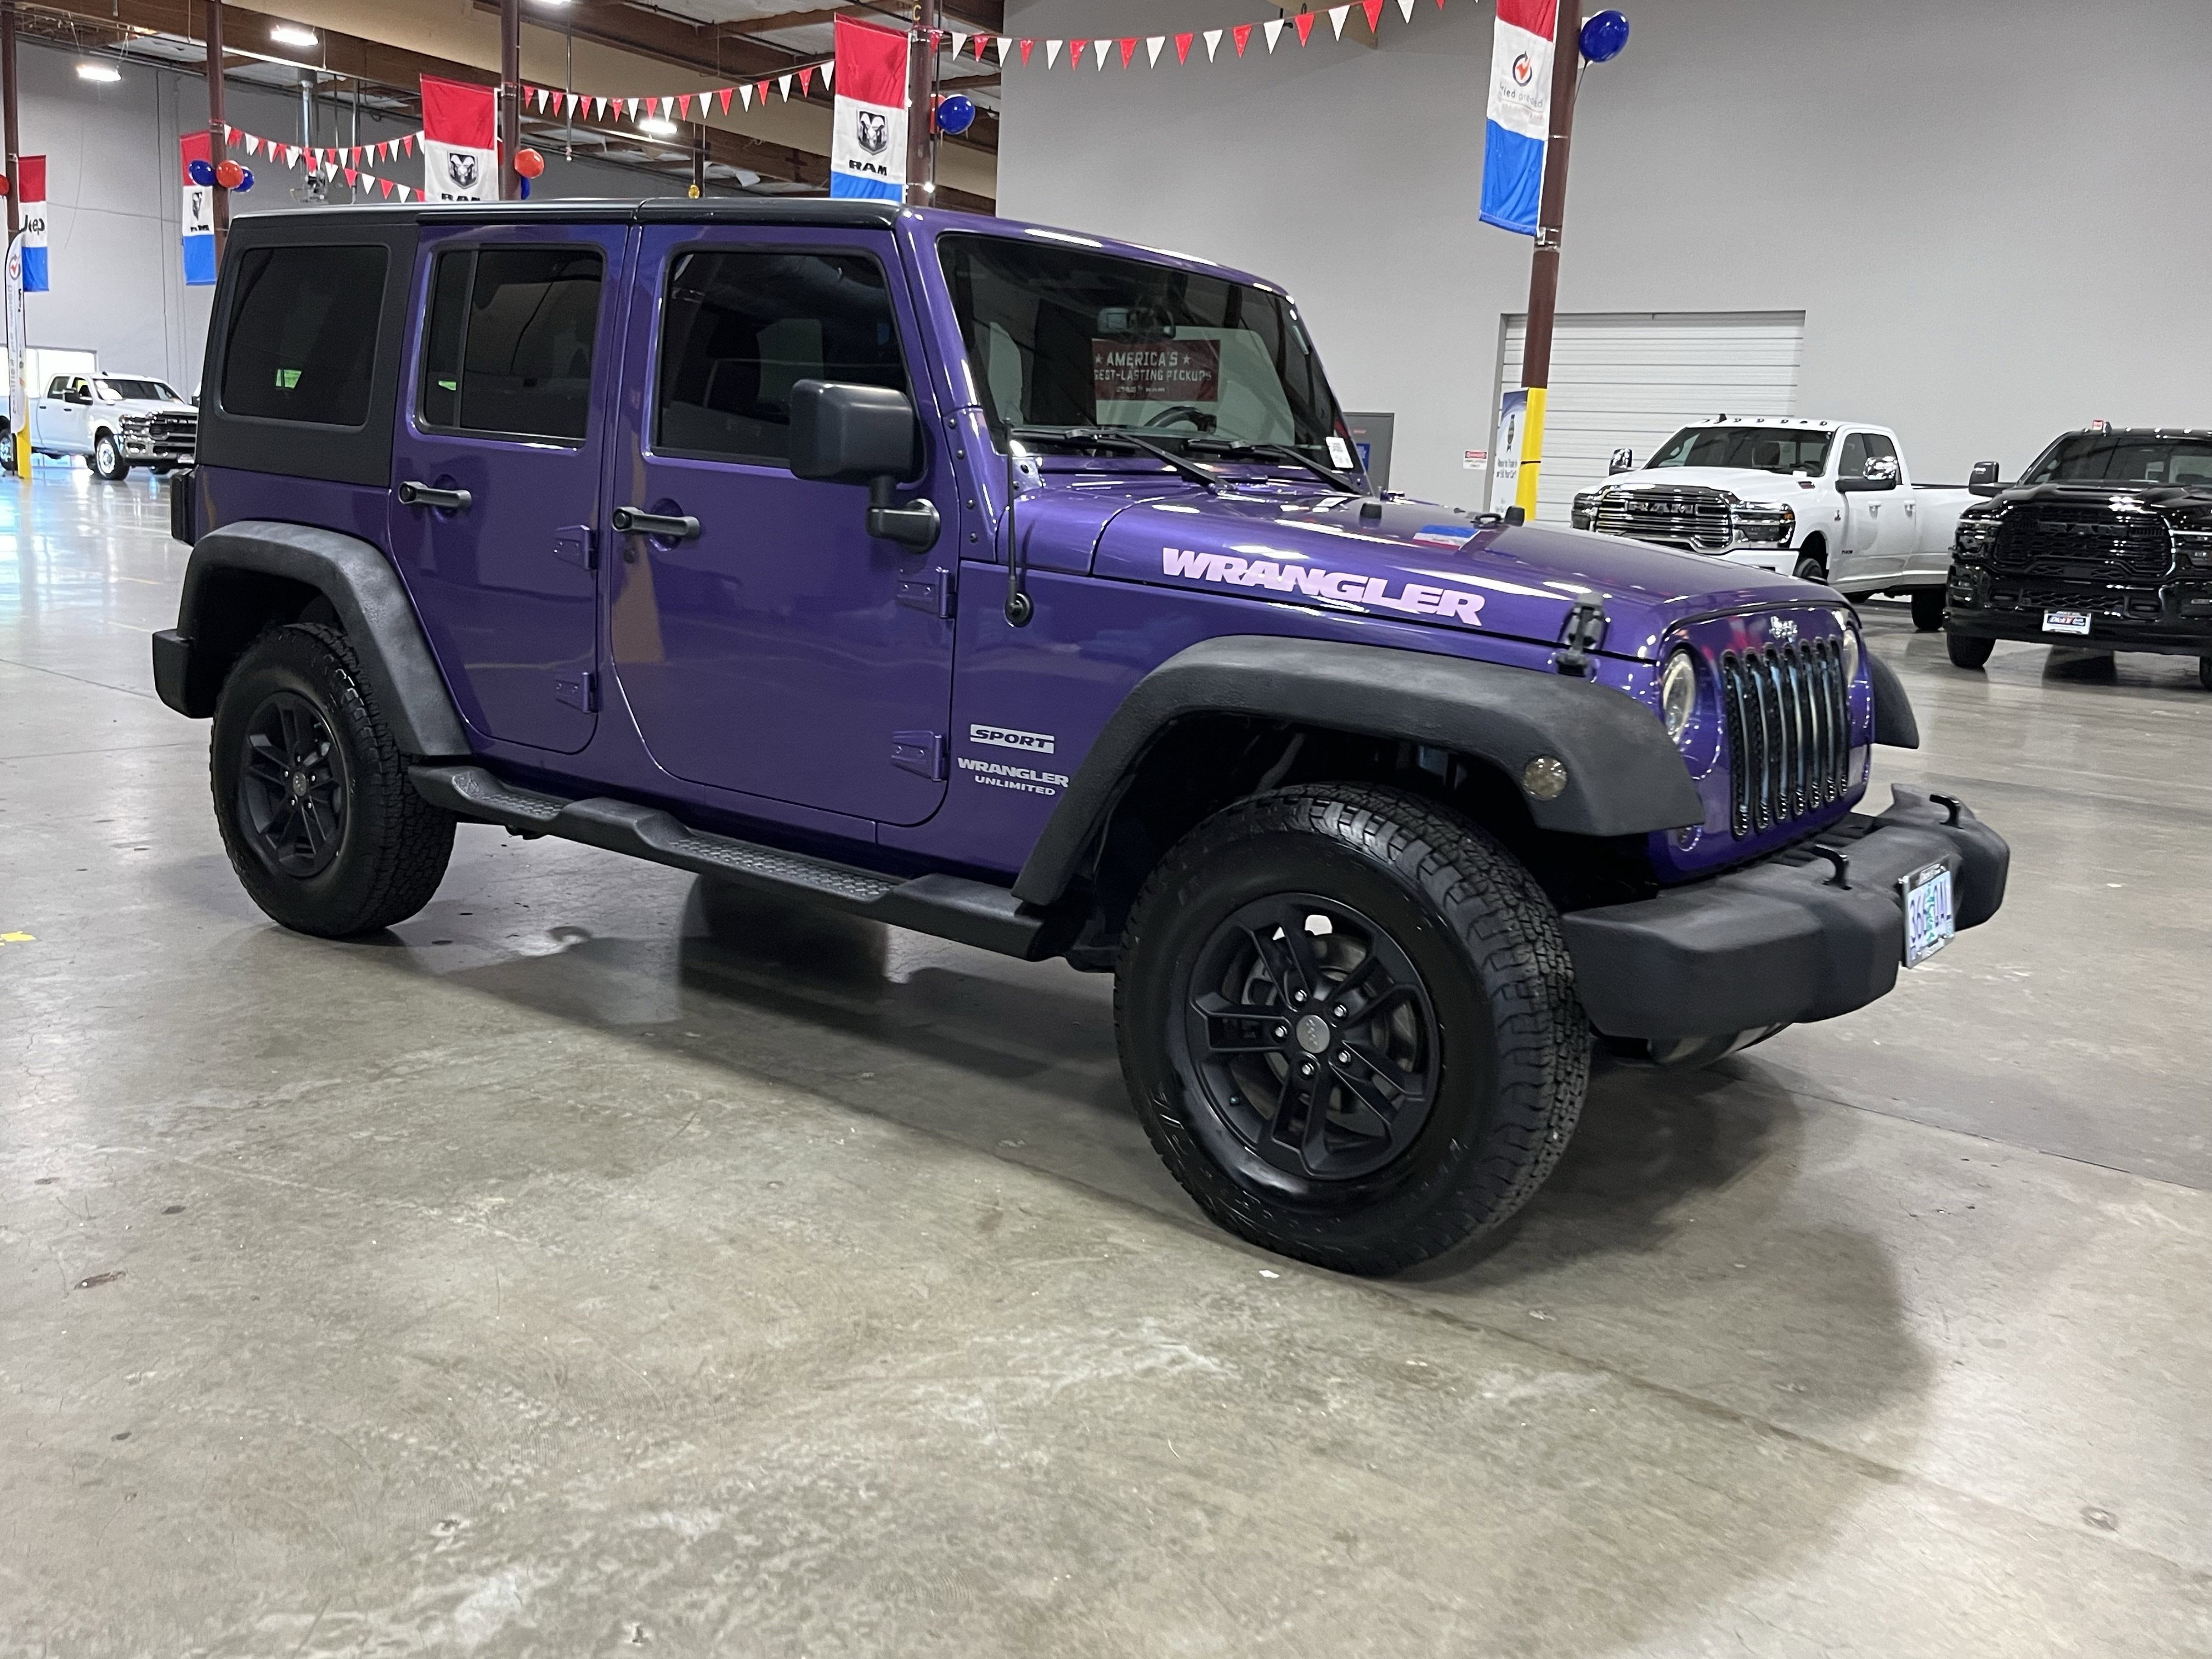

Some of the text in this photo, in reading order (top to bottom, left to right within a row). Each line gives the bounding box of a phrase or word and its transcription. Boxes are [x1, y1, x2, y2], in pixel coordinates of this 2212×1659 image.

[849, 159, 888, 176] RAM
[1107, 351, 1178, 367] AMERICA'S
[1628, 501, 1694, 515] RAM
[1163, 547, 1485, 627] WRANGLER
[970, 729, 1054, 748] SPORT
[957, 757, 1069, 788] WRANGLER
[974, 775, 1056, 795] UNLIMITED
